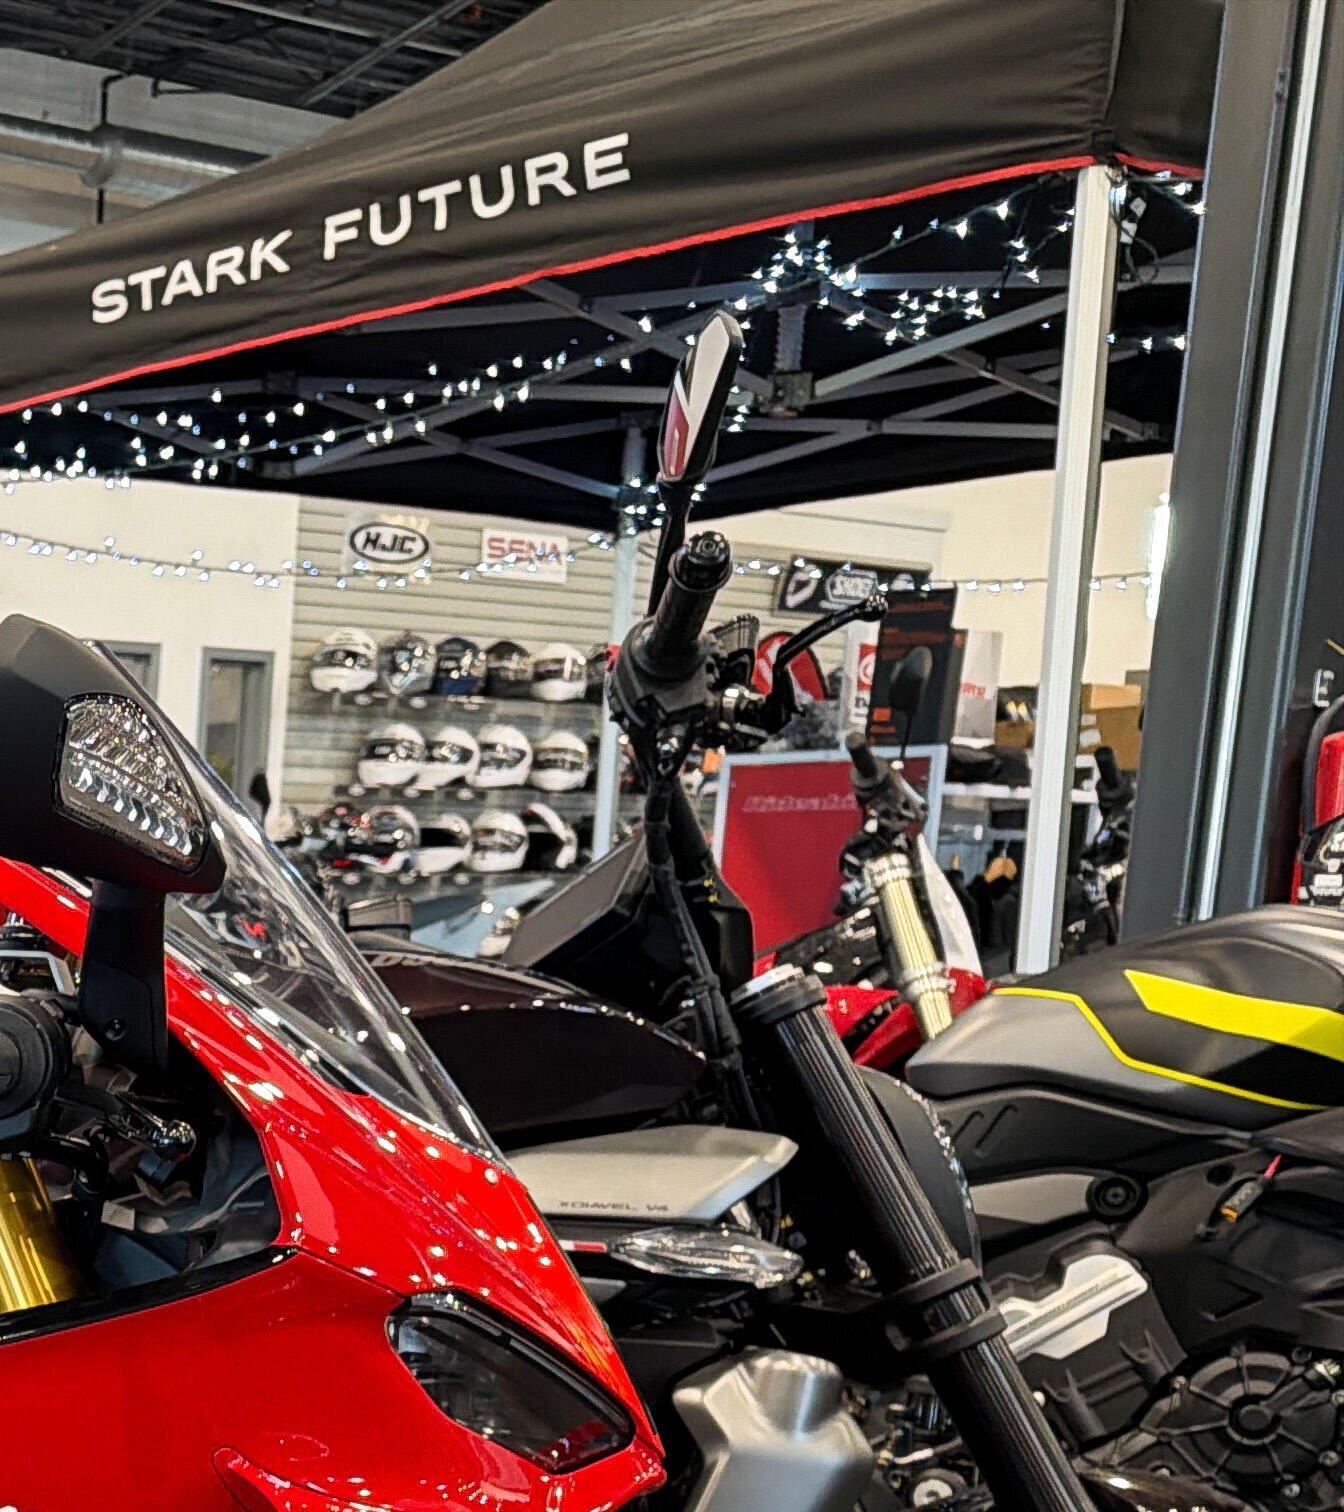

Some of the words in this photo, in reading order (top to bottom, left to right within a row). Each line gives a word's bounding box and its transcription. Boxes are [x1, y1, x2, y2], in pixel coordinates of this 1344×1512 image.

[90, 229, 295, 324] STARK
[322, 132, 632, 262] FUTURE
[362, 531, 417, 554] HJC
[486, 537, 563, 567] SENA
